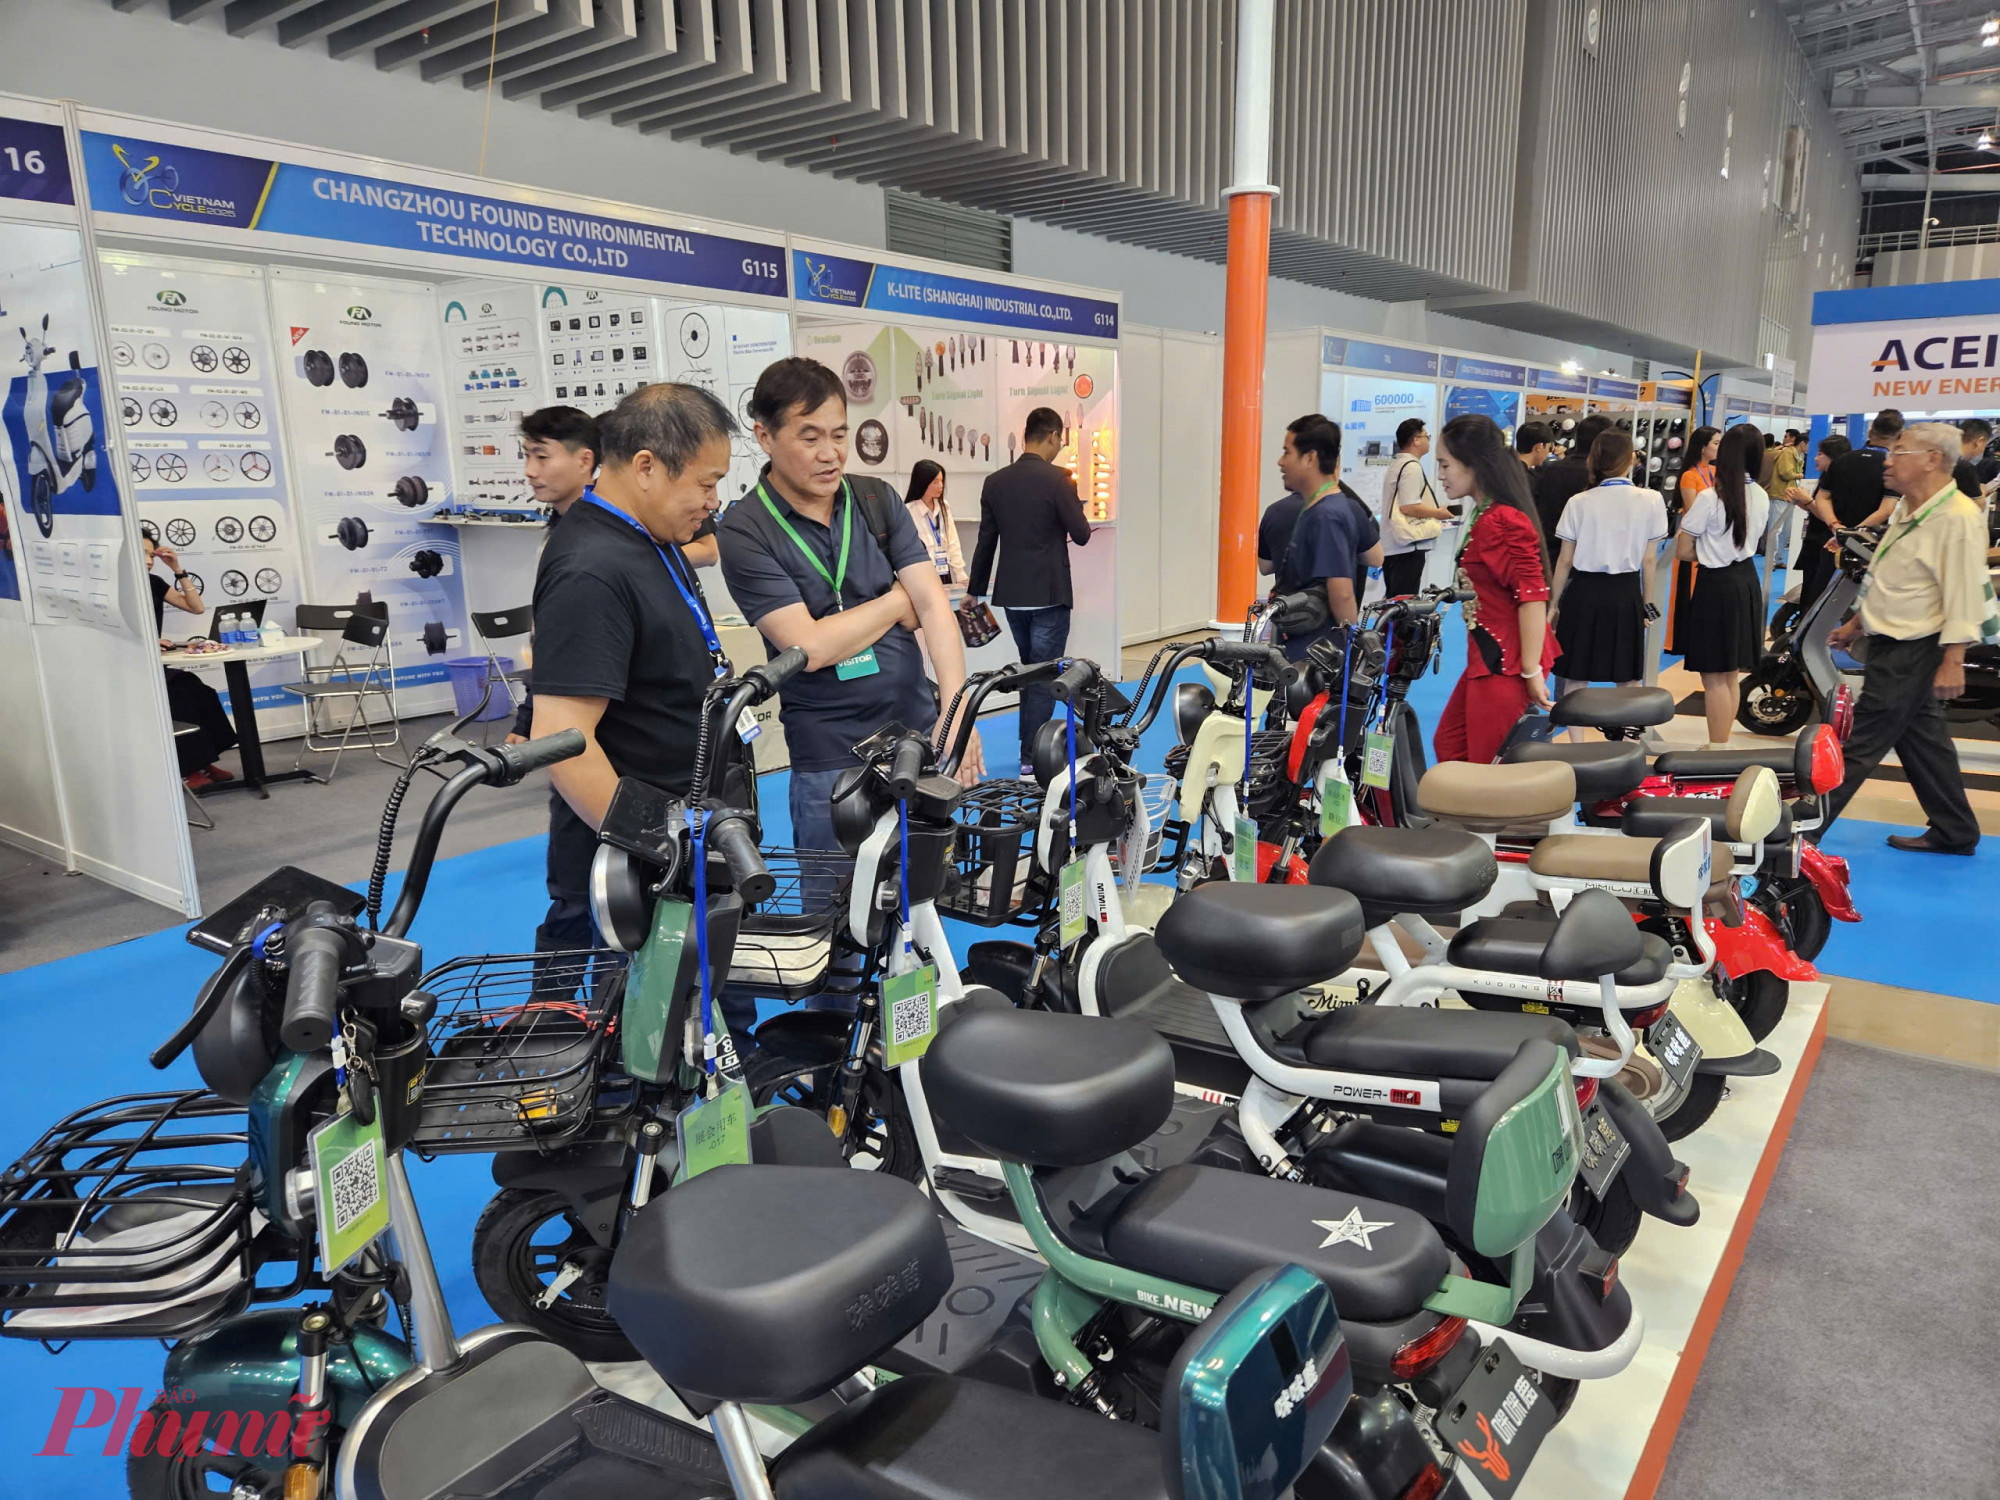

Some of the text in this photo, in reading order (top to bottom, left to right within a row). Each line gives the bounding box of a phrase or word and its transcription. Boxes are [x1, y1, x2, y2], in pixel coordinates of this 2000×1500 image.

[172, 193, 235, 209] VIETNAM
[313, 177, 695, 255] CHANGZHOU FOUND ENVIRONMENTAL
[416, 221, 629, 268] TECHNOLOGY CO.,LTD
[742, 258, 778, 279] G115
[887, 282, 1073, 322] K-LITE (SHANGHAI) INDUSTRIAL CO.,LTD.
[1094, 312, 1115, 327] G114
[1873, 379, 1932, 397] NEW
[1374, 393, 1414, 405] 600000
[838, 653, 872, 667] VISITOR
[1474, 980, 1540, 991] KUDONG
